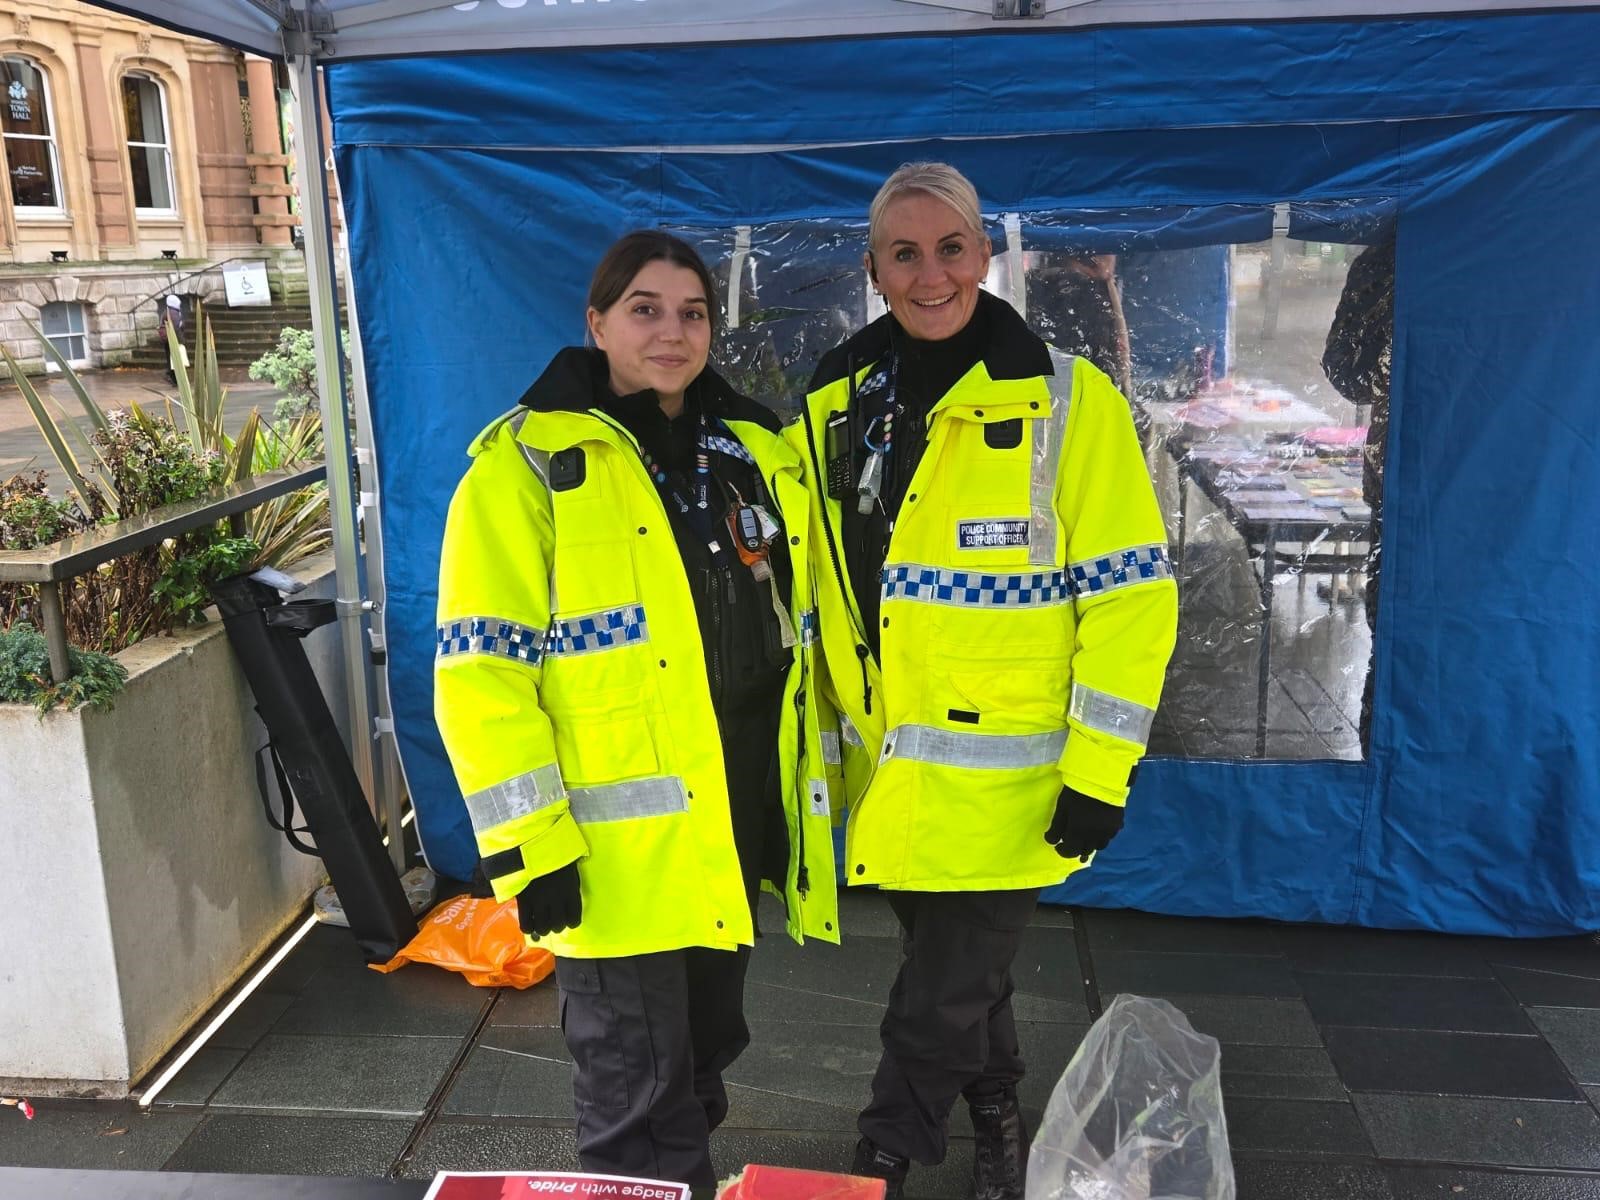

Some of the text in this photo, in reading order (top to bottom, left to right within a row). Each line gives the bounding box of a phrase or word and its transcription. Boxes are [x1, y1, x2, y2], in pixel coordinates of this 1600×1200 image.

[10, 104, 31, 113] TOWN
[12, 111, 31, 120] HALL
[961, 523, 1026, 535] POLICE COMMUNITY
[966, 534, 1024, 545] SUPPORT OFFICER
[527, 1180, 676, 1200] Badge with Pride.
